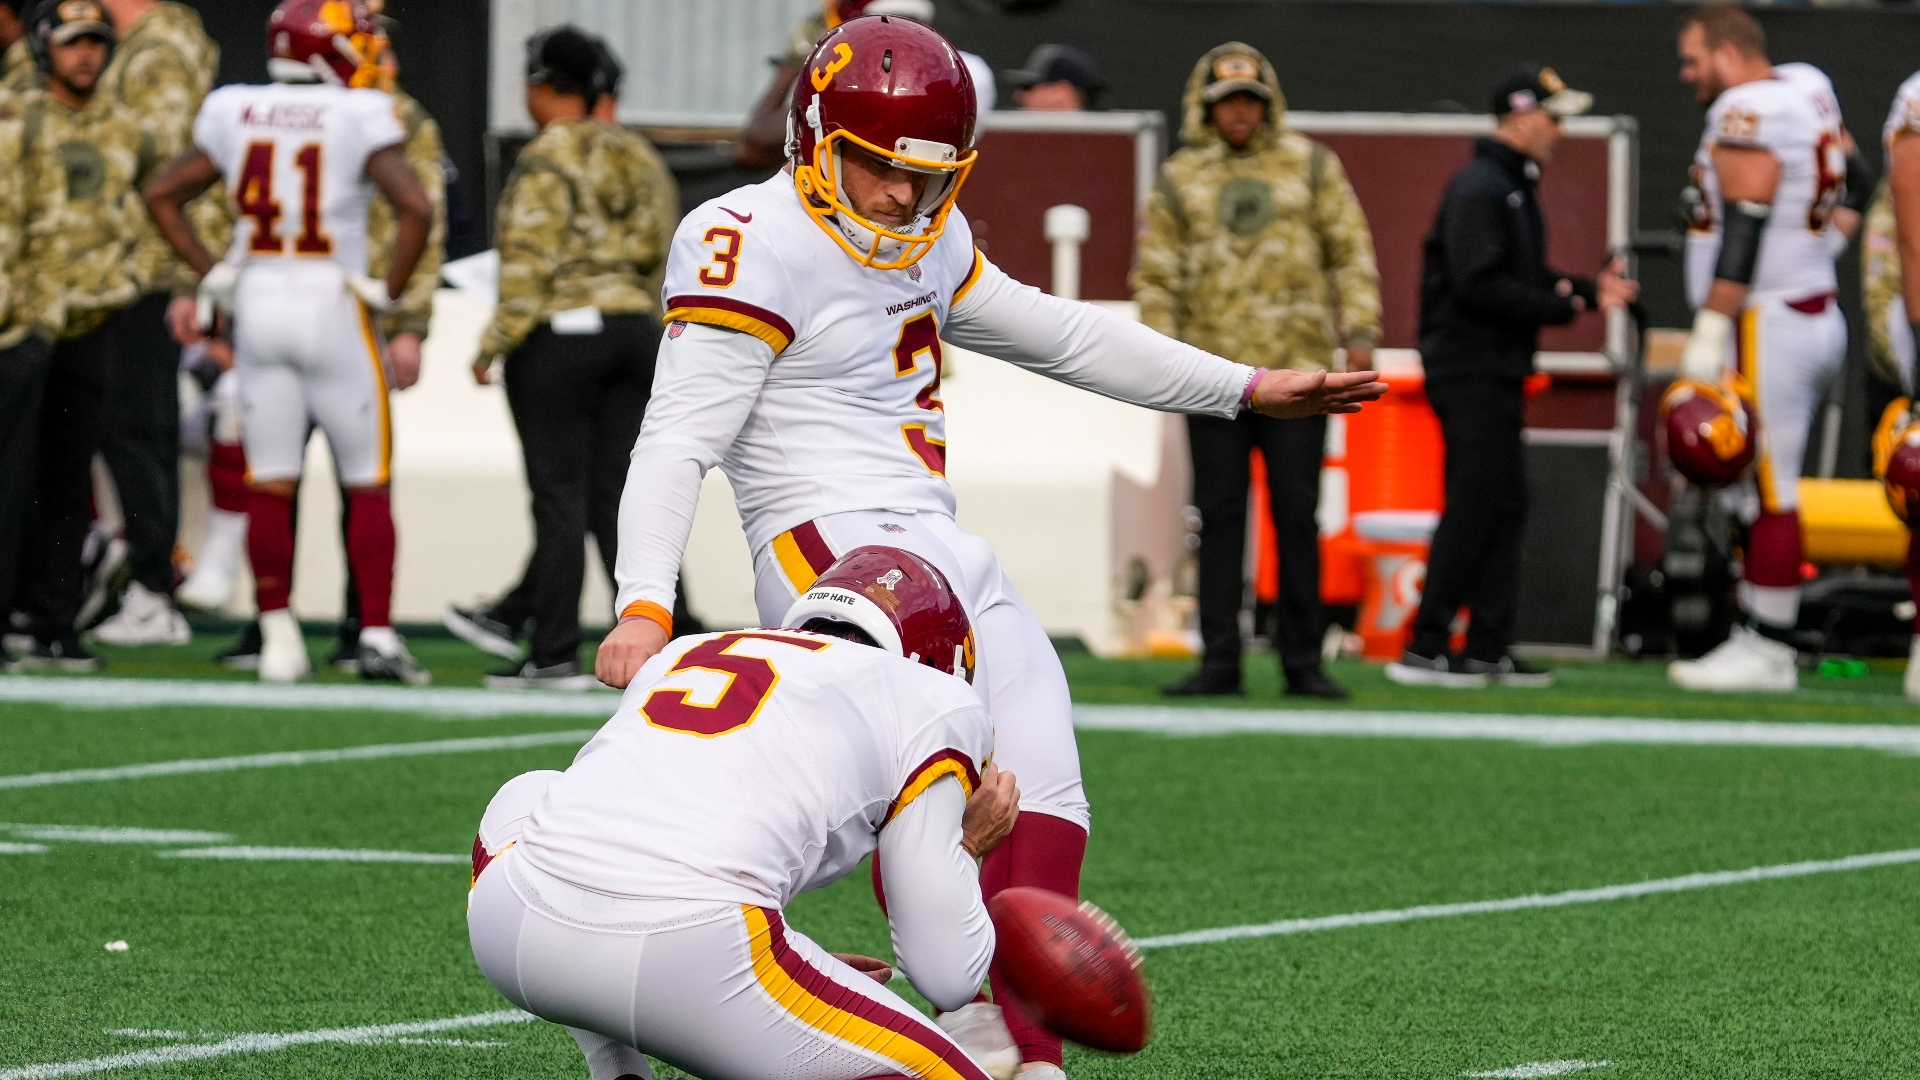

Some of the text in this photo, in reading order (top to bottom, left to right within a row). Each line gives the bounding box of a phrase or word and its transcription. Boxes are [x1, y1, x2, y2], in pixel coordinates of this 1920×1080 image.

[811, 42, 854, 92] 3
[236, 139, 334, 255] 41
[697, 224, 744, 290] 3
[892, 308, 947, 480] 3
[807, 592, 856, 606] STOP HATE
[637, 631, 834, 739] 5
